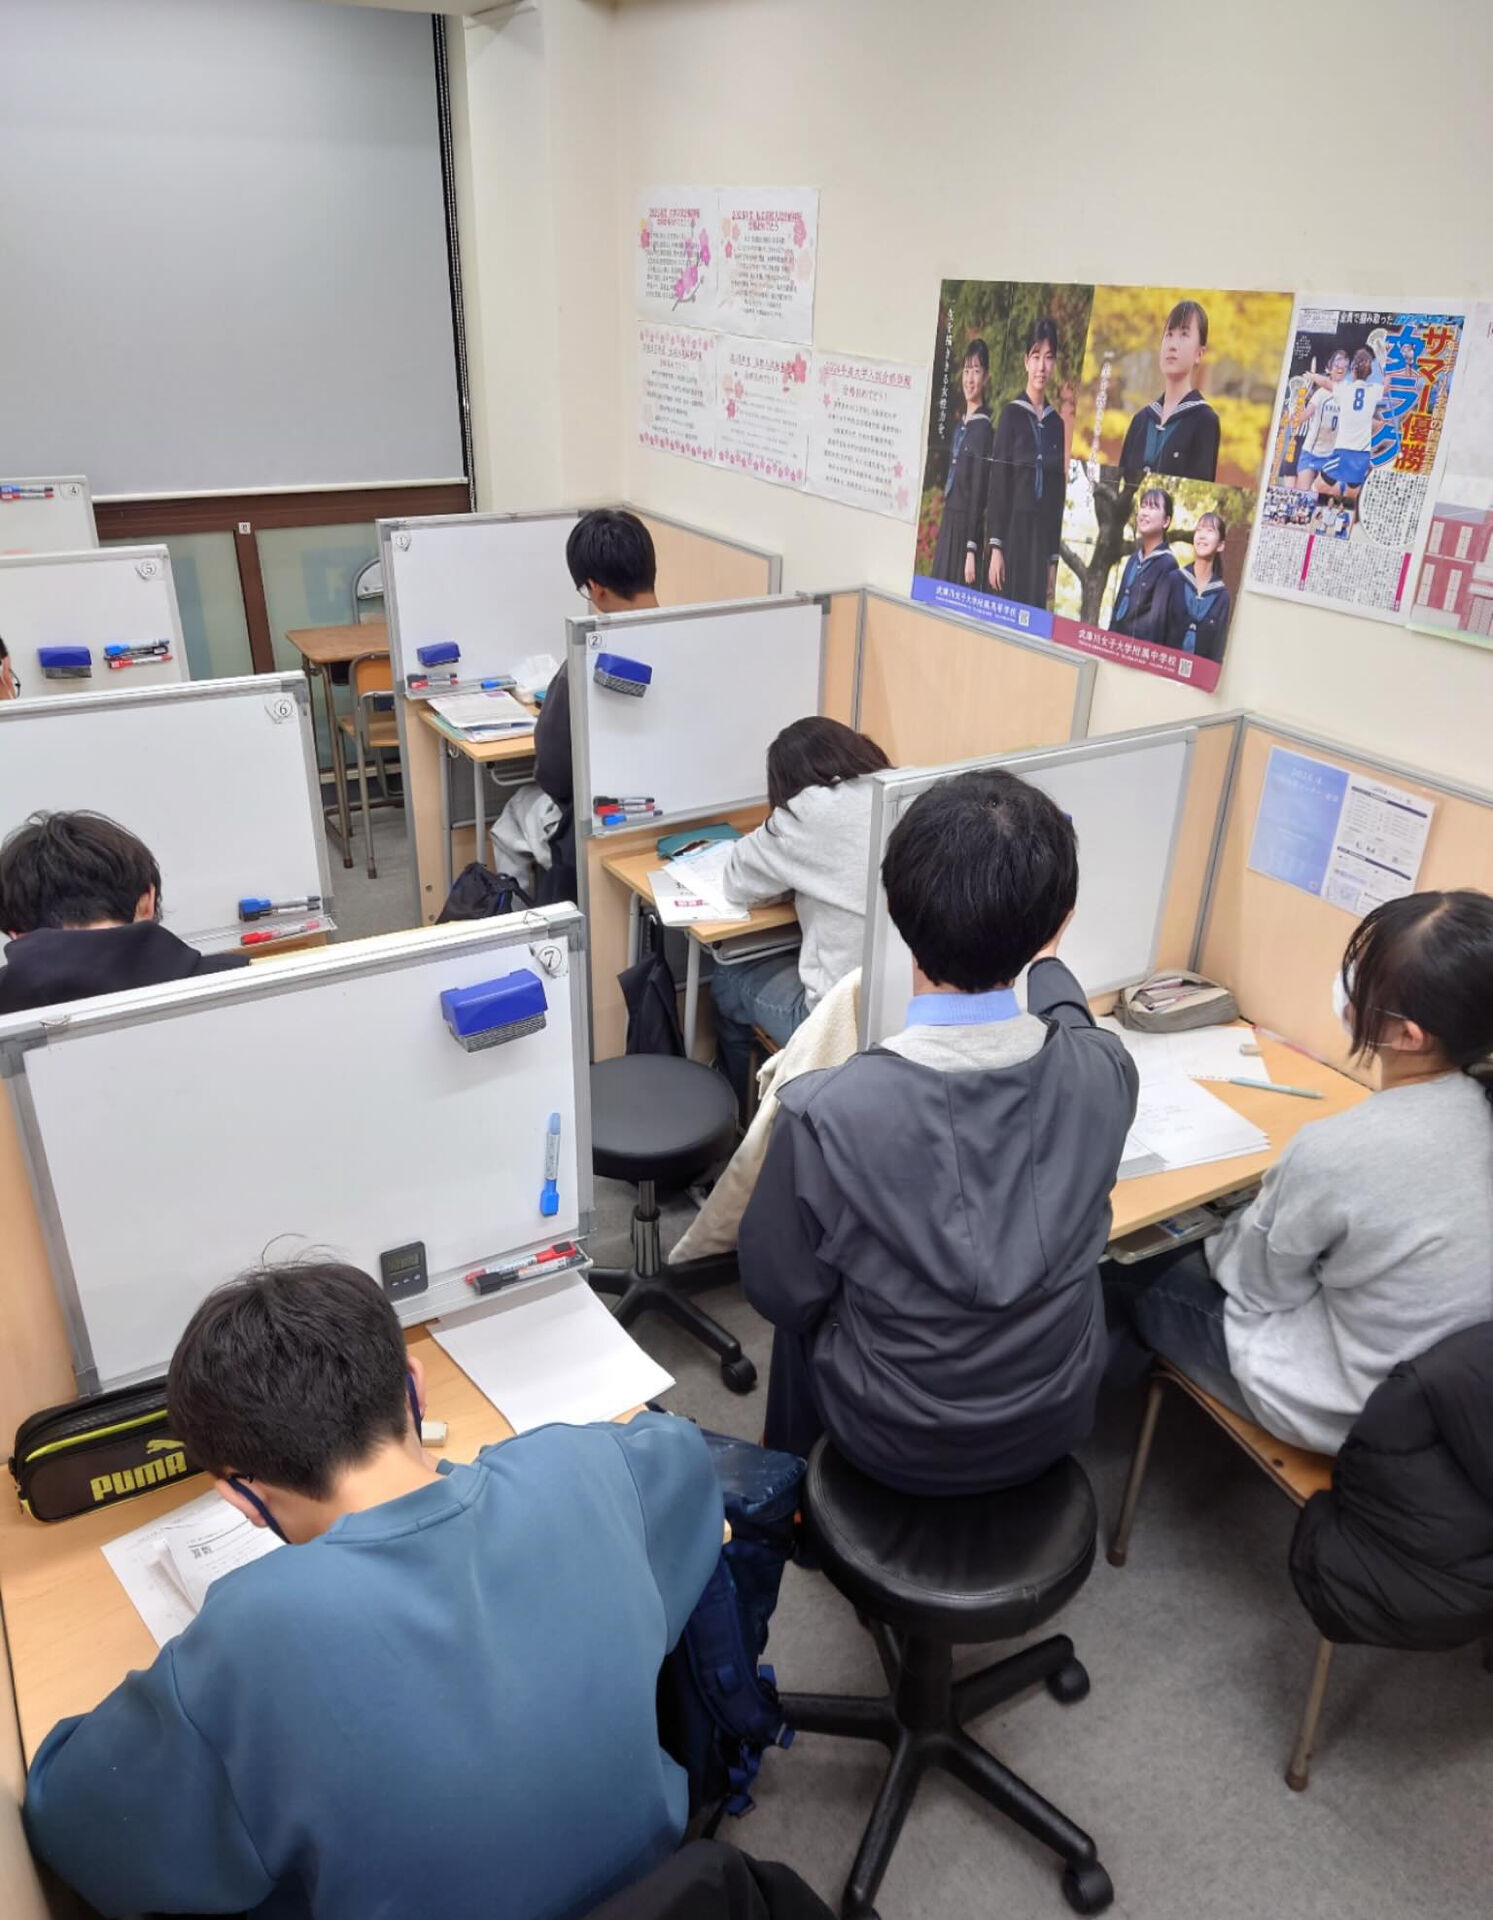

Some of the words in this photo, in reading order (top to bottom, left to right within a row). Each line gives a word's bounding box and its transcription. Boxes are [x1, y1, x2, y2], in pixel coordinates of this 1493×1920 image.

[1353, 388, 1365, 411] 8
[1393, 326, 1454, 473] サマー優勝
[1078, 629, 1178, 667] 武庫川女子大学附属中学校
[89, 1450, 187, 1502] PUMA
